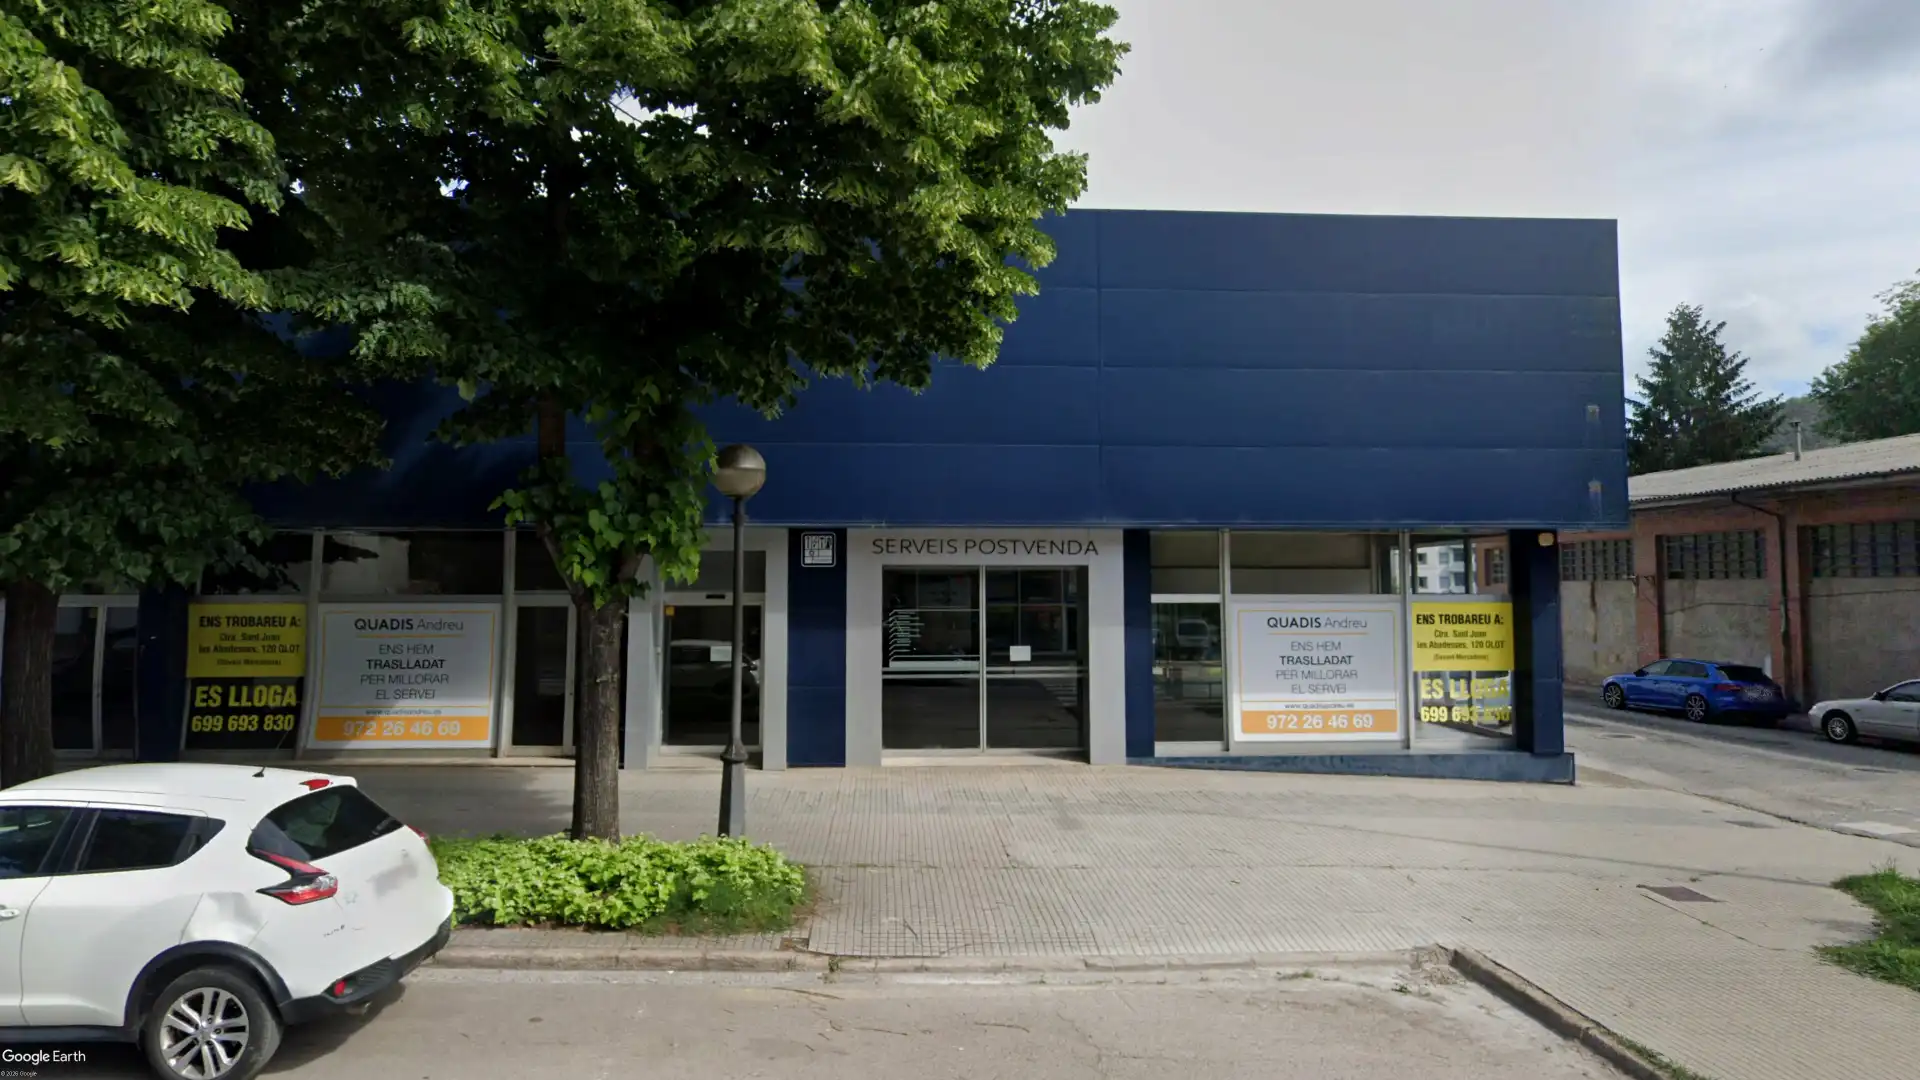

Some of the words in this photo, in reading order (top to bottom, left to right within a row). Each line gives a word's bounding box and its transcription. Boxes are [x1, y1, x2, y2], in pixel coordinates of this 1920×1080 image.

[872, 537, 958, 556] SERVEIS
[964, 538, 1099, 557] POSTVENDA
[199, 615, 222, 628] ENS
[225, 615, 287, 629] TROBAREU
[290, 615, 302, 628] A:
[354, 618, 414, 631] QUADIS
[416, 618, 464, 631] Andreu
[1267, 616, 1322, 629] QUADIS
[1323, 615, 1368, 629] Andreu
[1416, 613, 1435, 625] ENS
[1438, 613, 1491, 625] TROBAREU
[1494, 613, 1505, 625] A:
[379, 644, 404, 655] ENS
[406, 644, 434, 655] HEM
[1291, 641, 1314, 652] ENS
[1316, 641, 1341, 652] HEM
[1471, 640, 1485, 649] 120
[1485, 640, 1506, 650] OLOT
[366, 659, 446, 670] TRASLLADAT
[1279, 655, 1354, 666] TRASLLADAT
[360, 673, 385, 685] PER
[388, 673, 450, 685] MILLORAR
[1276, 669, 1298, 680] PER
[1301, 669, 1358, 680] MILLORAR
[375, 689, 390, 700] EL
[392, 688, 436, 700] SERVEI
[1291, 684, 1304, 694] EL
[1308, 683, 1347, 694] SERVEI
[1421, 679, 1444, 700] ES
[194, 685, 223, 708] ES
[228, 685, 297, 708] LLOGA
[1421, 706, 1448, 722] 699
[191, 715, 223, 732] 699
[227, 714, 259, 732] 693
[263, 714, 295, 731] 830
[1266, 714, 1298, 730] 972
[1302, 714, 1323, 729] 26
[1327, 714, 1349, 729] 46
[1352, 713, 1374, 729] 69
[343, 720, 376, 736] 972
[382, 720, 405, 736] 26
[409, 720, 434, 736] 46
[437, 720, 461, 736] 69
